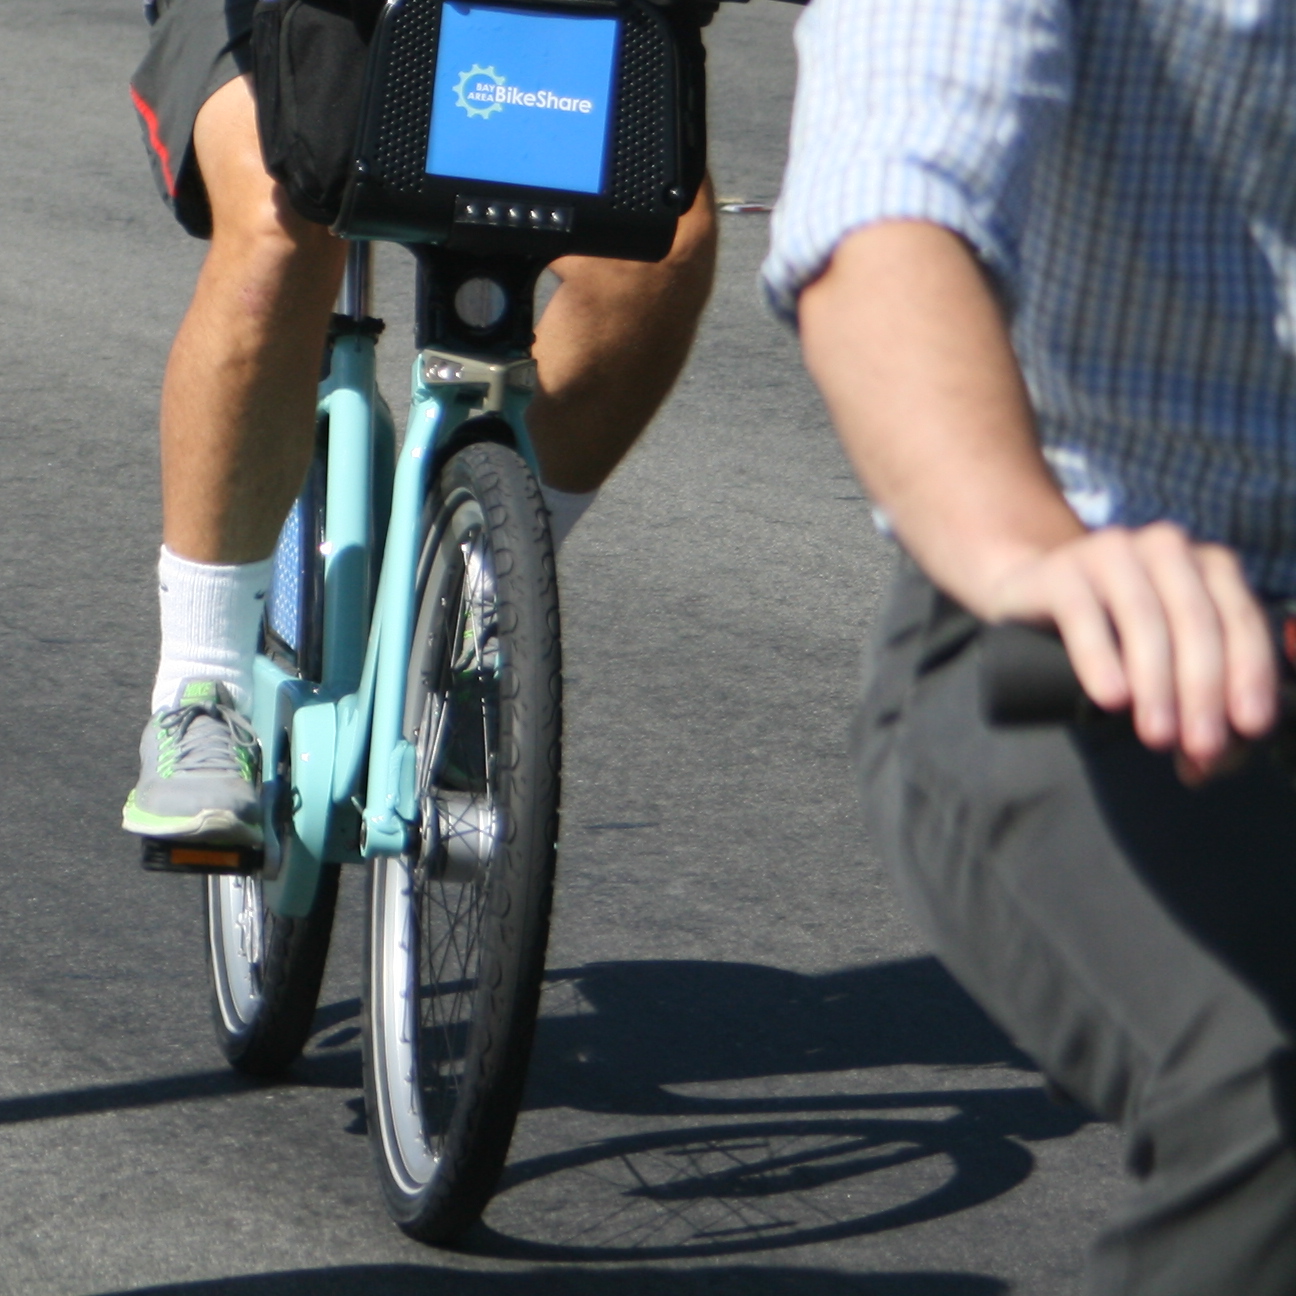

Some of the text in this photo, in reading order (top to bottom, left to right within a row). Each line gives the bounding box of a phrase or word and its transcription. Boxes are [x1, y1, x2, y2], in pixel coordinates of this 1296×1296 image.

[476, 83, 496, 93] BAY
[467, 92, 495, 102] AREA
[495, 85, 594, 114] BikeShare
